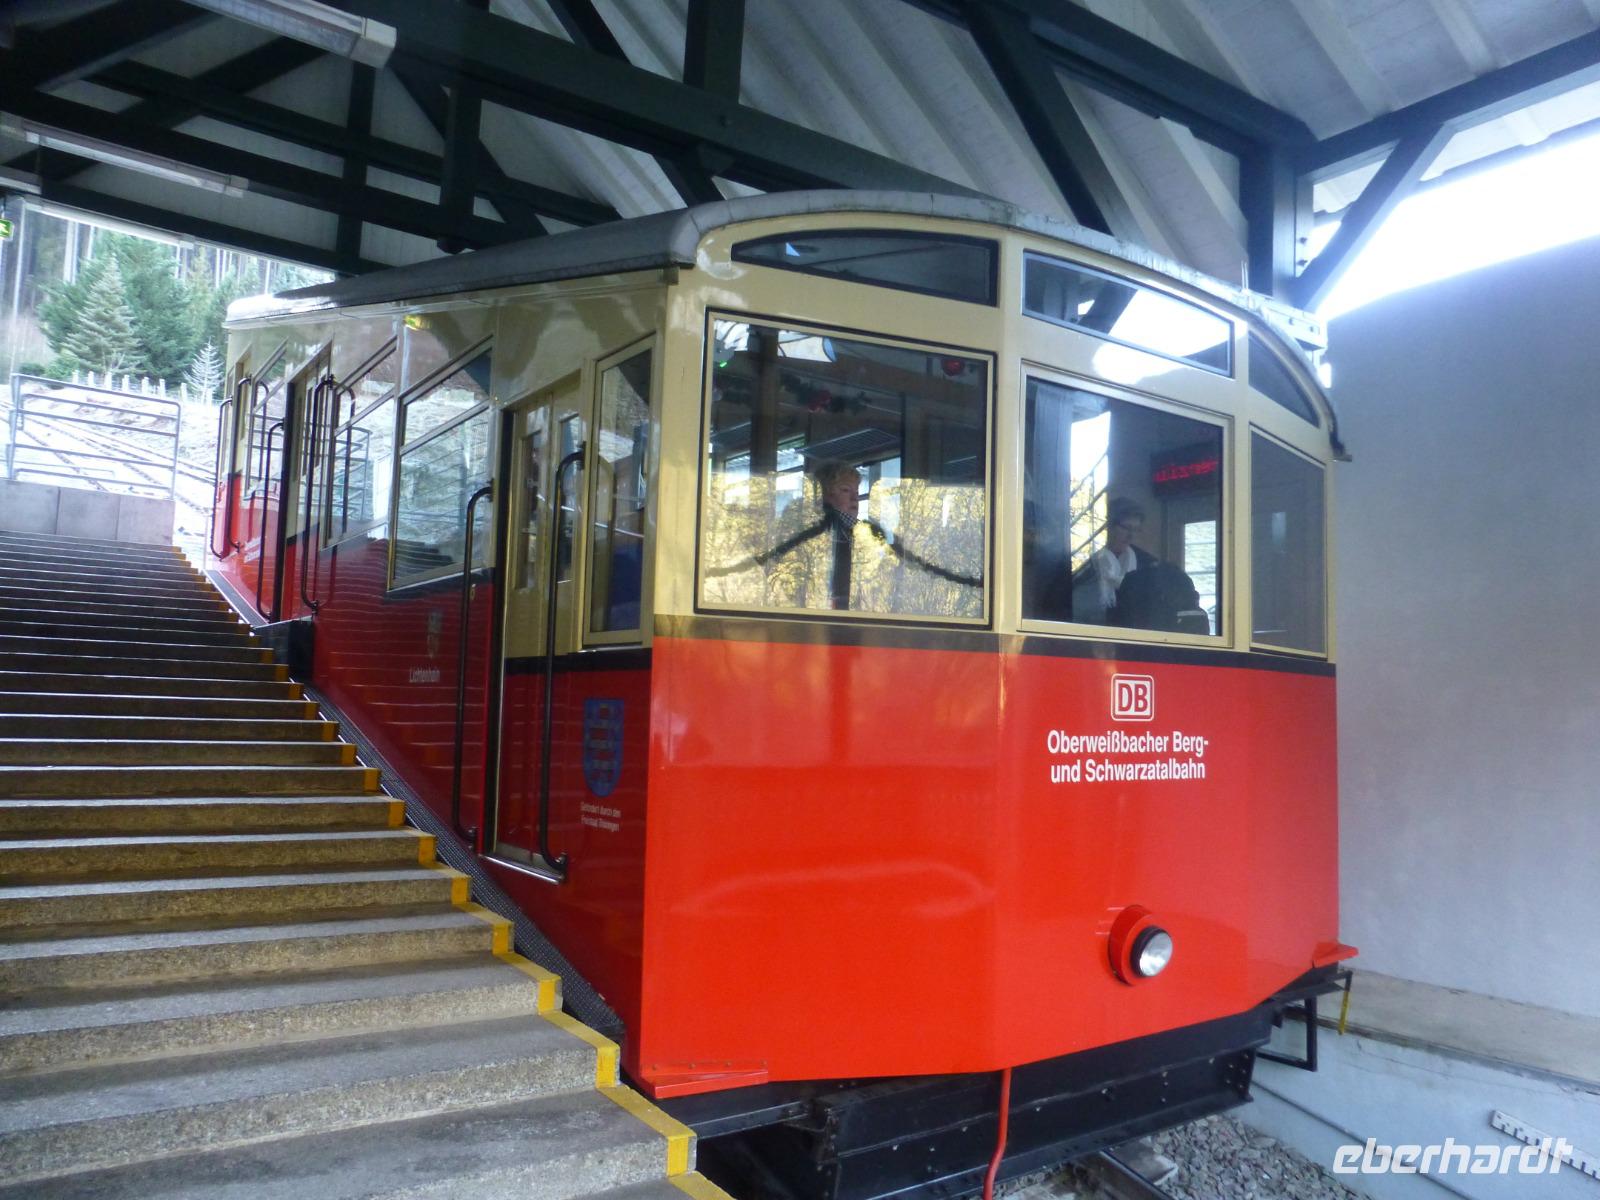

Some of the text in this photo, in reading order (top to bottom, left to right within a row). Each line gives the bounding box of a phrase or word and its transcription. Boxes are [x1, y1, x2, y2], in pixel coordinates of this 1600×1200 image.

[1116, 681, 1150, 714] DB
[1047, 729, 1209, 757] Oberweißbacher Berg-
[1051, 758, 1206, 783] und Schwarzatalbahn
